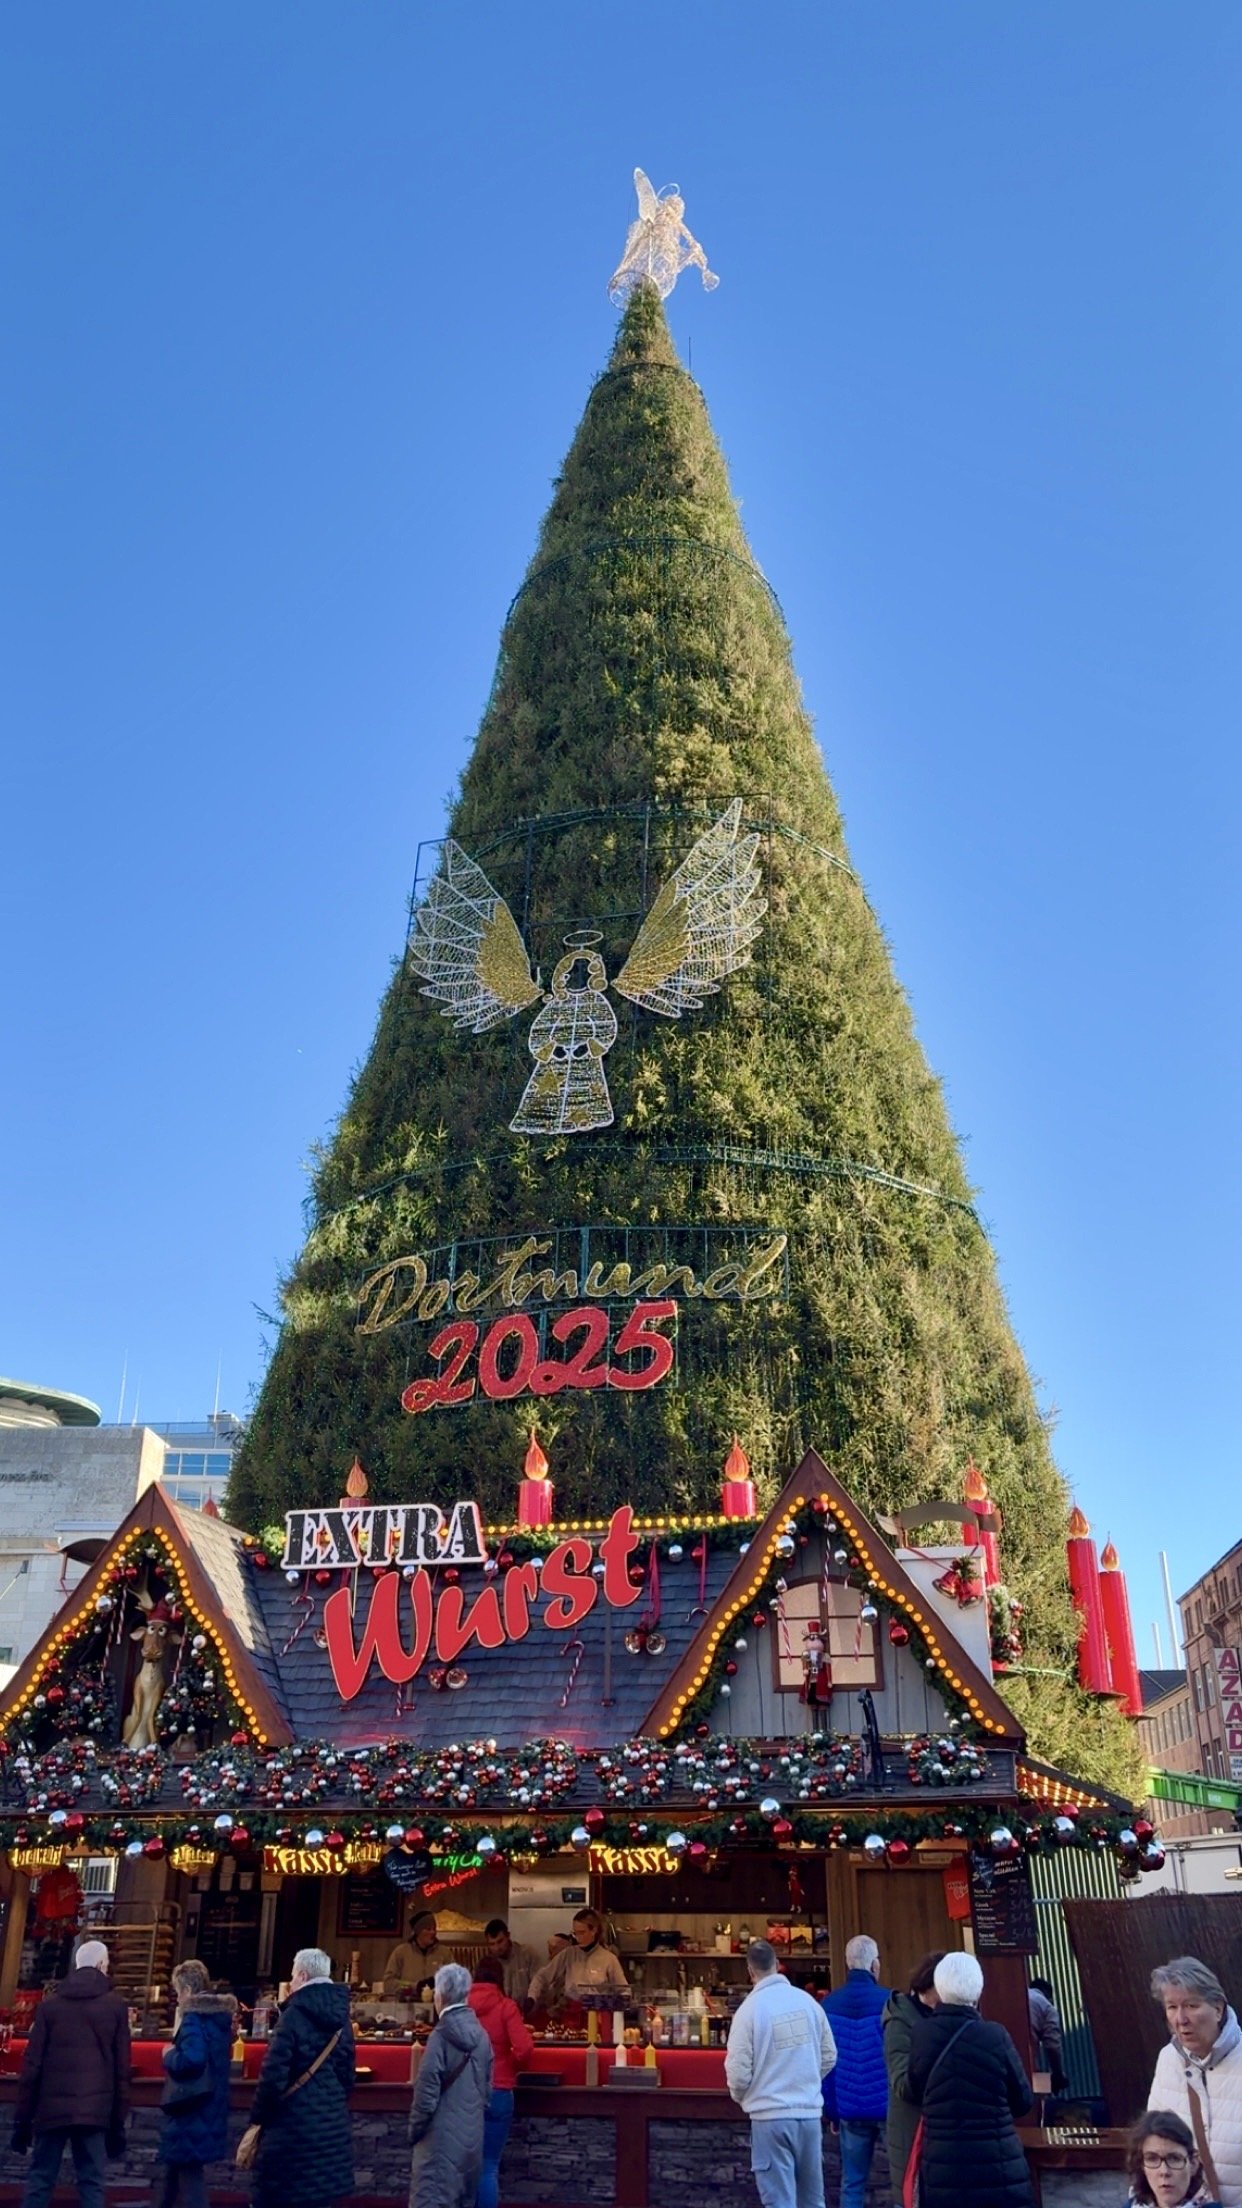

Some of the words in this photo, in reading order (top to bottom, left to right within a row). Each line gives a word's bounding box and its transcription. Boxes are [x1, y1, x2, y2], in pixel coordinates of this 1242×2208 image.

[354, 1234, 788, 1335] Dortmund
[401, 1299, 679, 1414] 2025
[283, 1504, 484, 1567] EXTRA
[324, 1505, 643, 1701] Wurst
[264, 1845, 348, 1874] Kasse
[589, 1845, 680, 1874] Kasse
